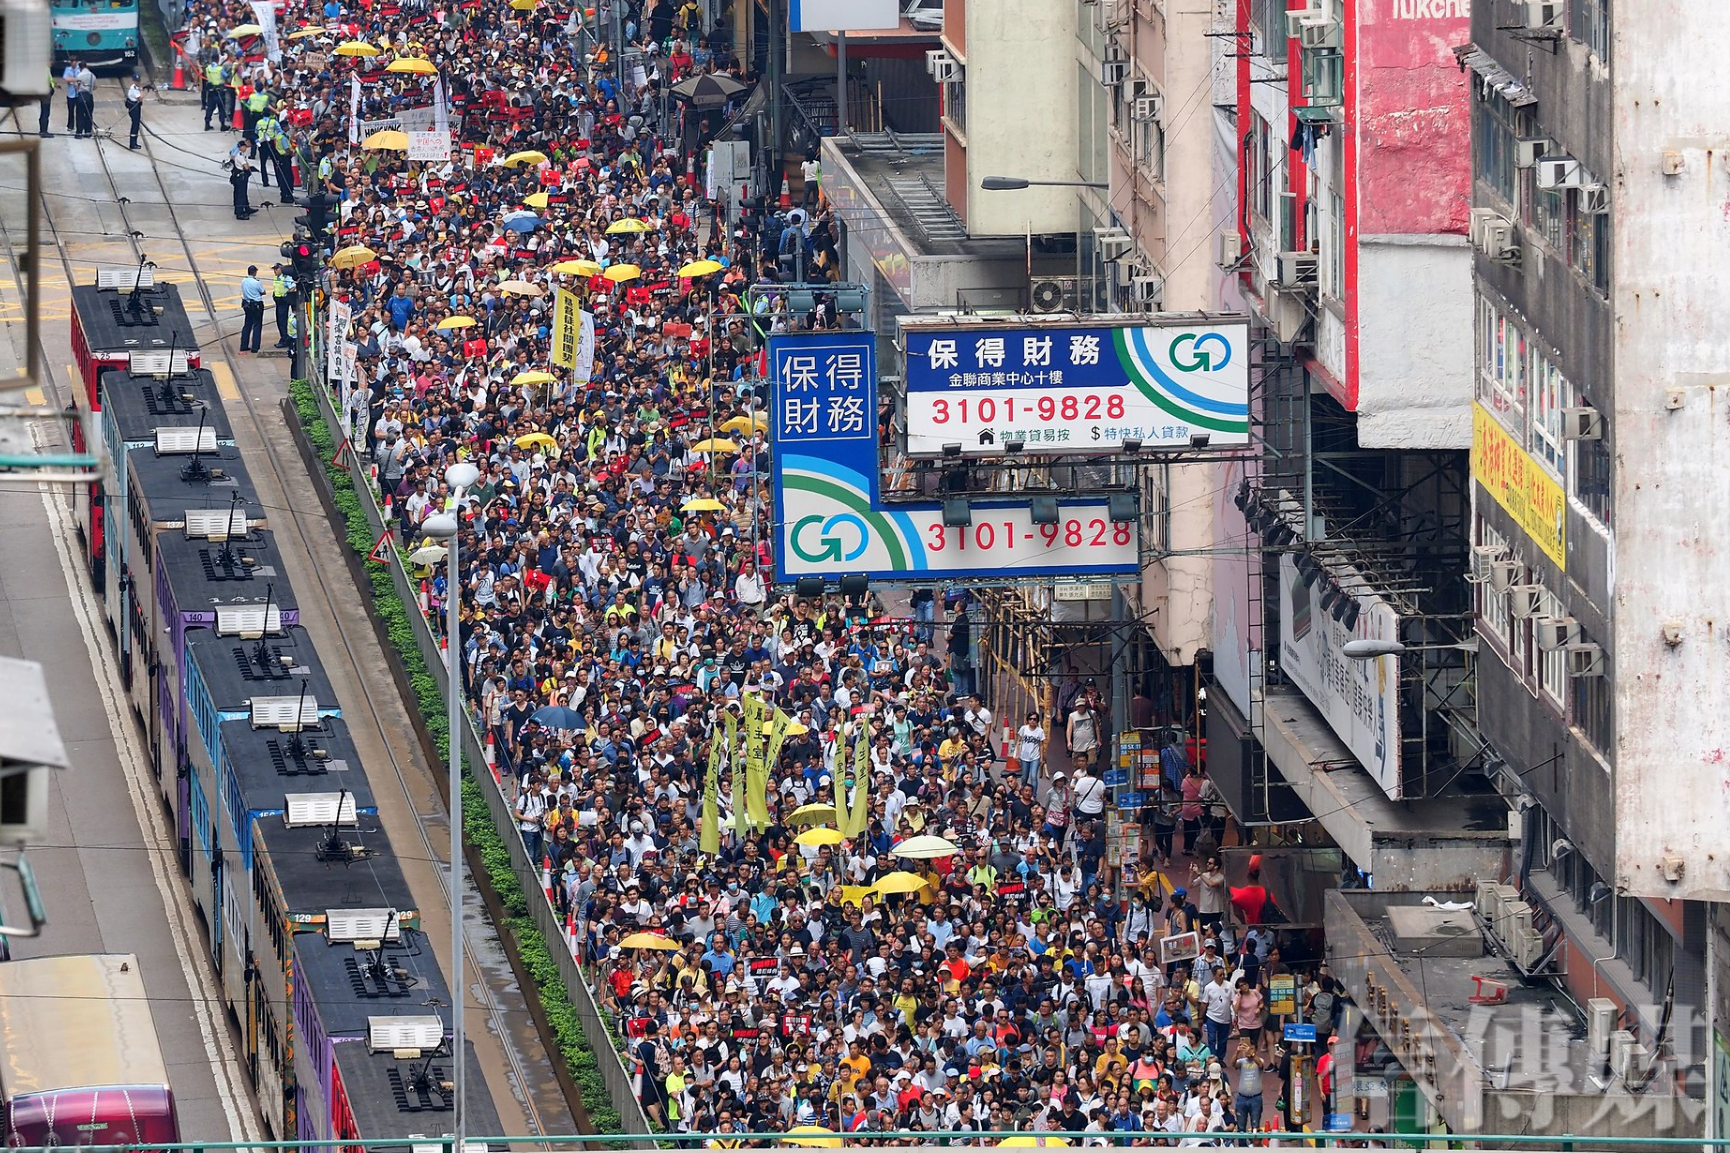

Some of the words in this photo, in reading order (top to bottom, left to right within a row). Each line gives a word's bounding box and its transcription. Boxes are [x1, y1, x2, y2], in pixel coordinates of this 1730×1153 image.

[927, 334, 1100, 369] 保得財務
[948, 370, 1064, 387] 金聯商業中心十樓
[932, 393, 1126, 425] 3101-9828
[927, 519, 1132, 552] 3101-9828
[189, 613, 203, 622] 140
[295, 914, 312, 923] 129
[397, 911, 413, 920] 129
